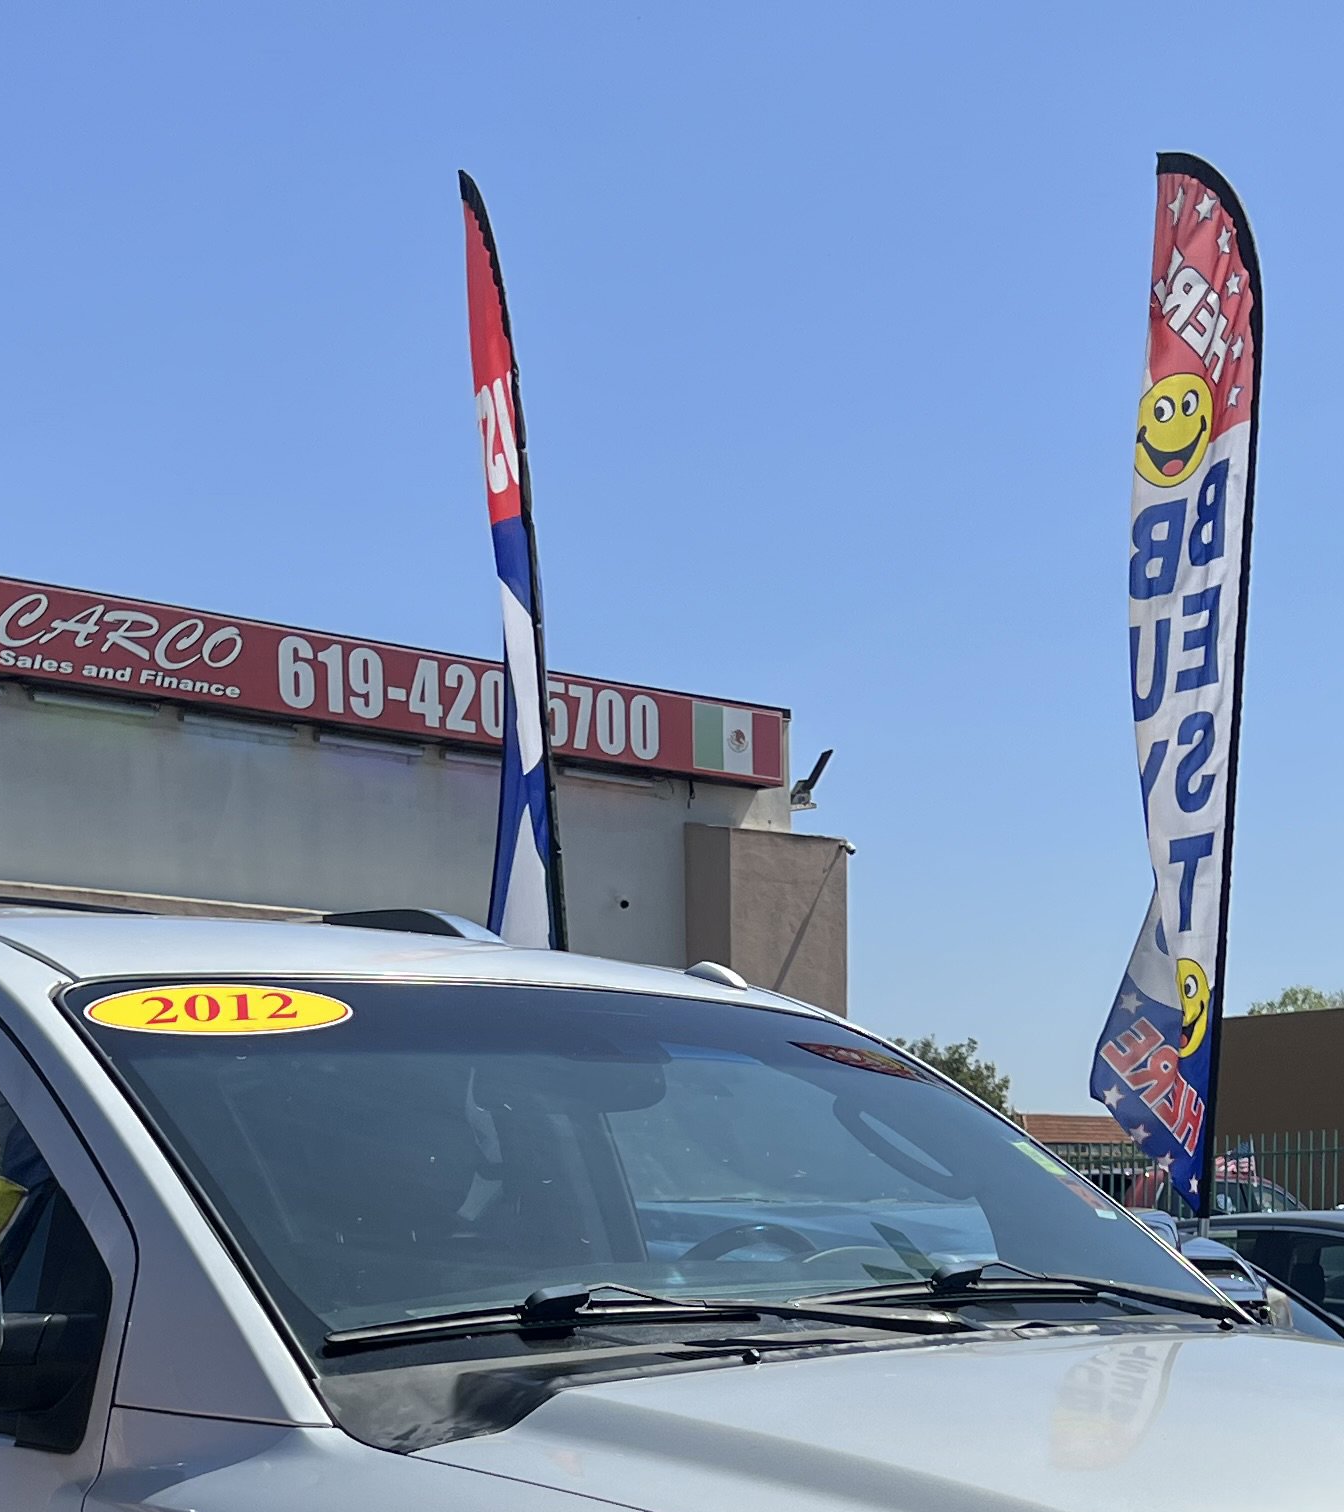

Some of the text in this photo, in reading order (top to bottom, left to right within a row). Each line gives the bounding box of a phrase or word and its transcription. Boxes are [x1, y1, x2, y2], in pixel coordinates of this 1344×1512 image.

[82, 661, 132, 683] and
[140, 670, 241, 698] Finance
[278, 635, 660, 761] 619-4205700
[141, 992, 298, 1025] 2012
